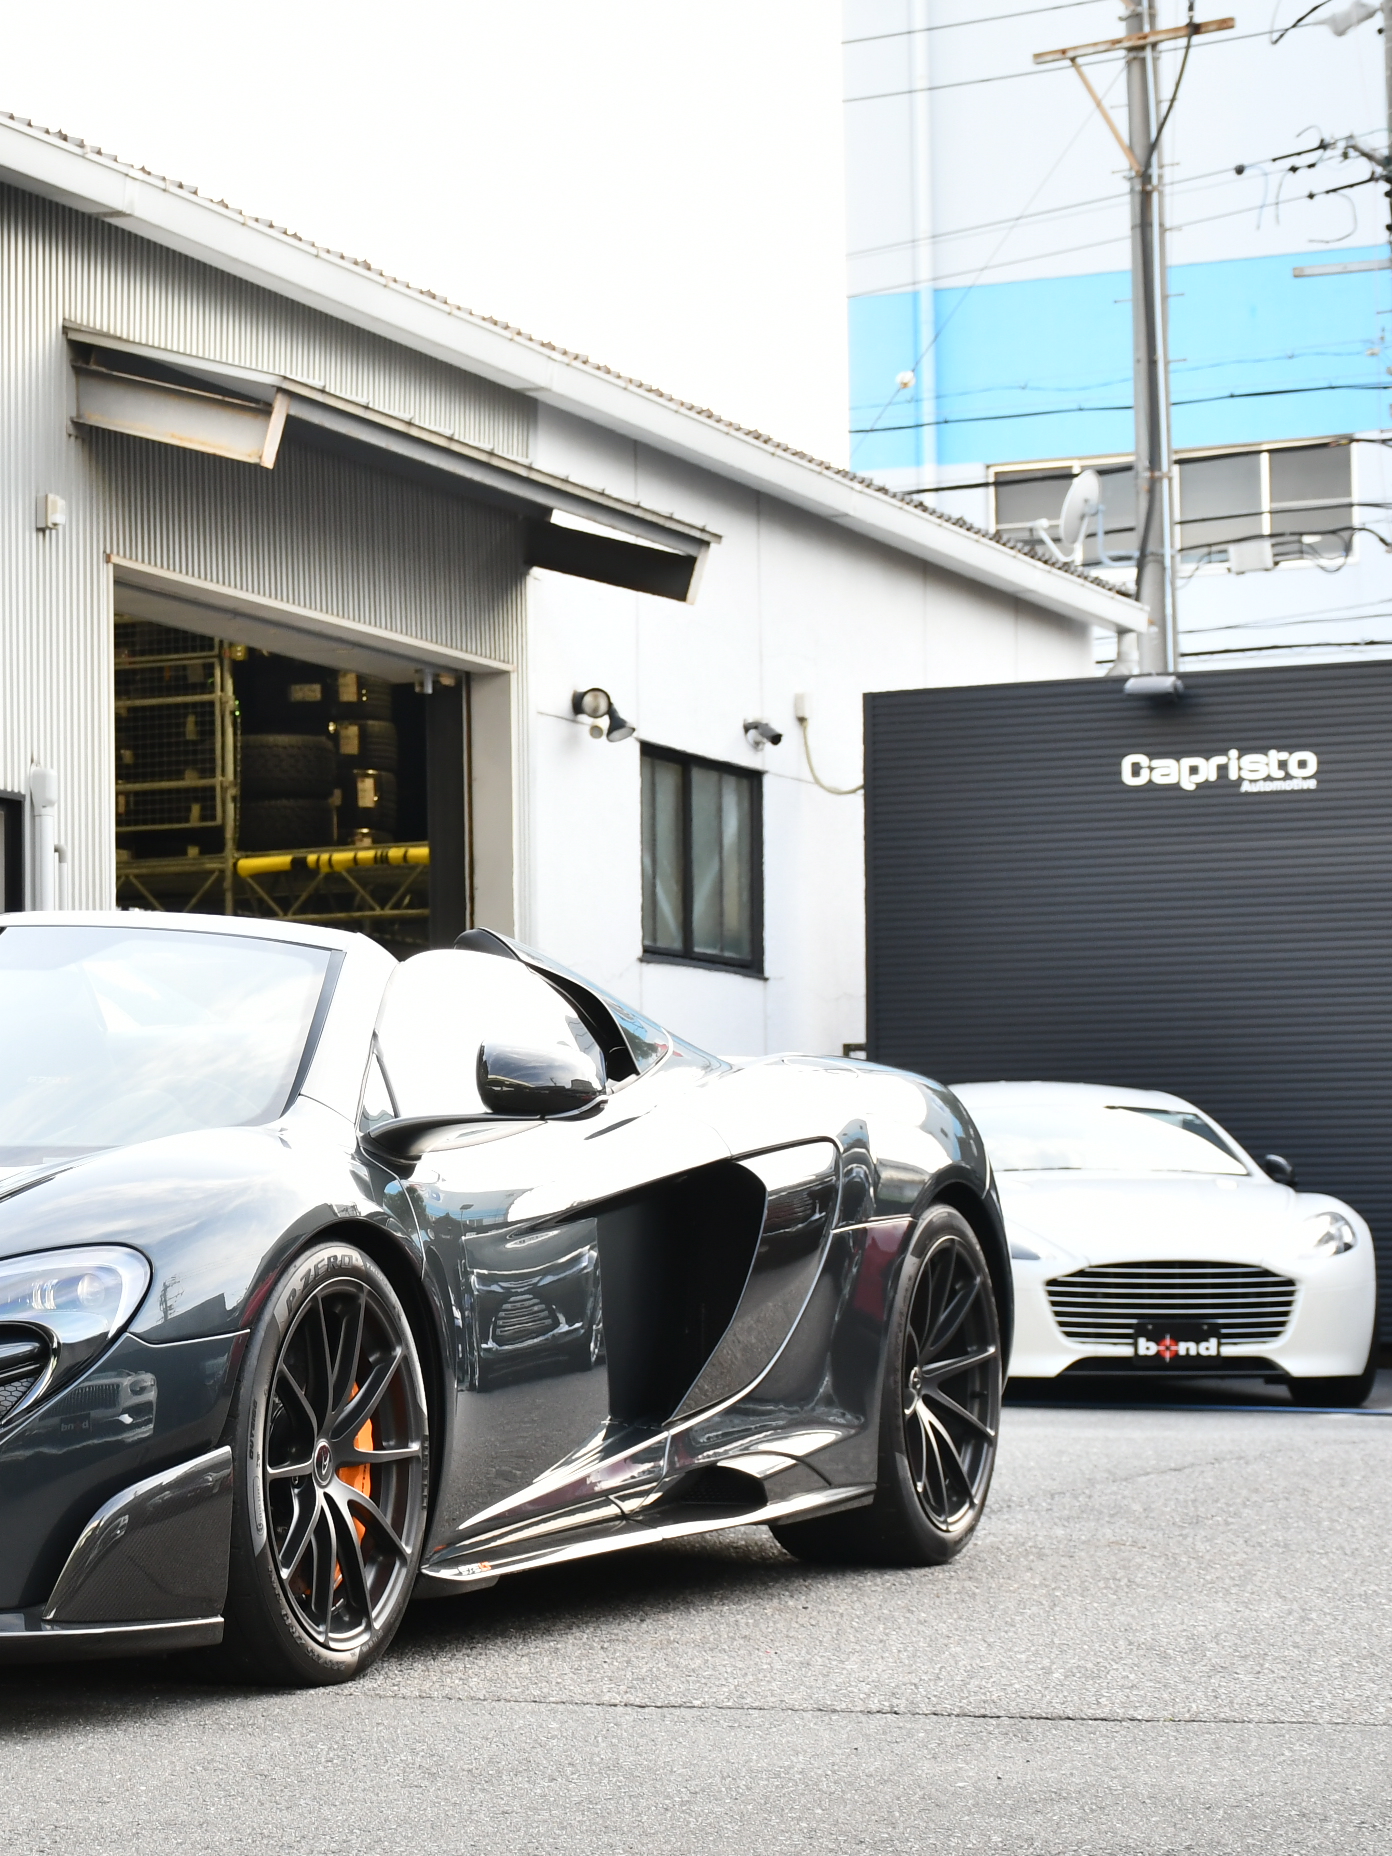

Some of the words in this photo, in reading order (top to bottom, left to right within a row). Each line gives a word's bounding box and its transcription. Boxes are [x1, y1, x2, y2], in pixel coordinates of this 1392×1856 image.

[1121, 748, 1318, 791] Capristo
[1240, 777, 1318, 793] Automotive
[1136, 1336, 1218, 1360] bond
